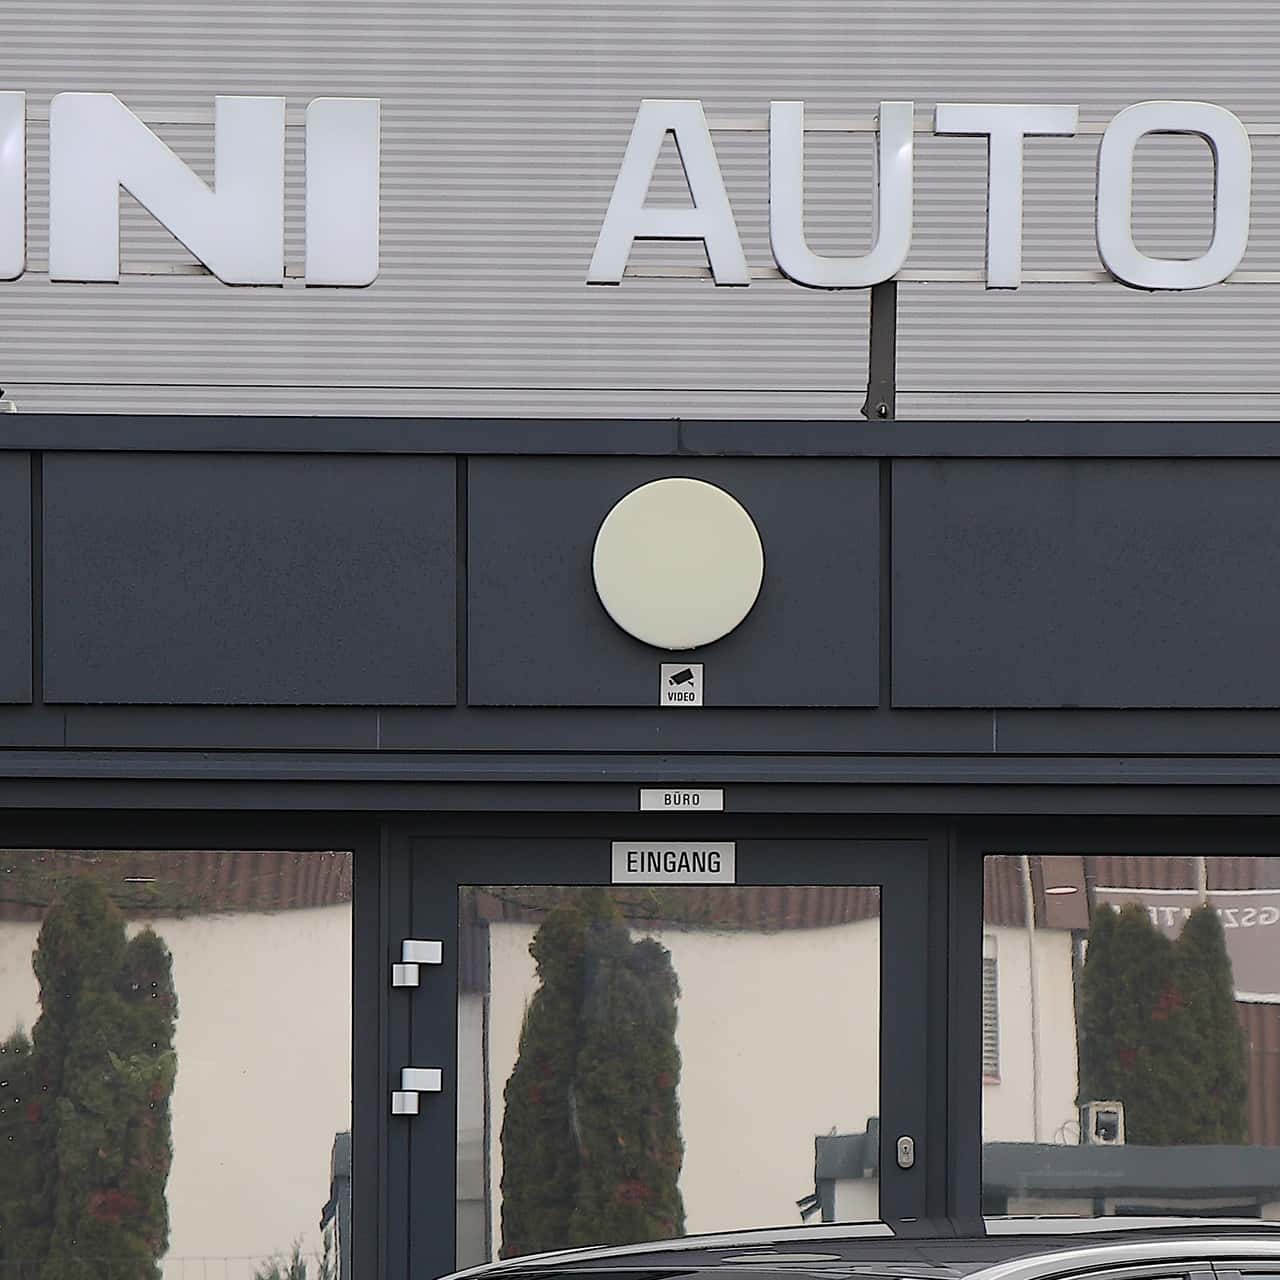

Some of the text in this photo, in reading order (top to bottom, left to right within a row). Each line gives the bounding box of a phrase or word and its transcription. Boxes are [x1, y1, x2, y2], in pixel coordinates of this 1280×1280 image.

[587, 99, 1253, 292] AUTO
[668, 692, 695, 702] VIDEO
[664, 791, 700, 806] BÜRO
[627, 851, 721, 873] EINGANG
